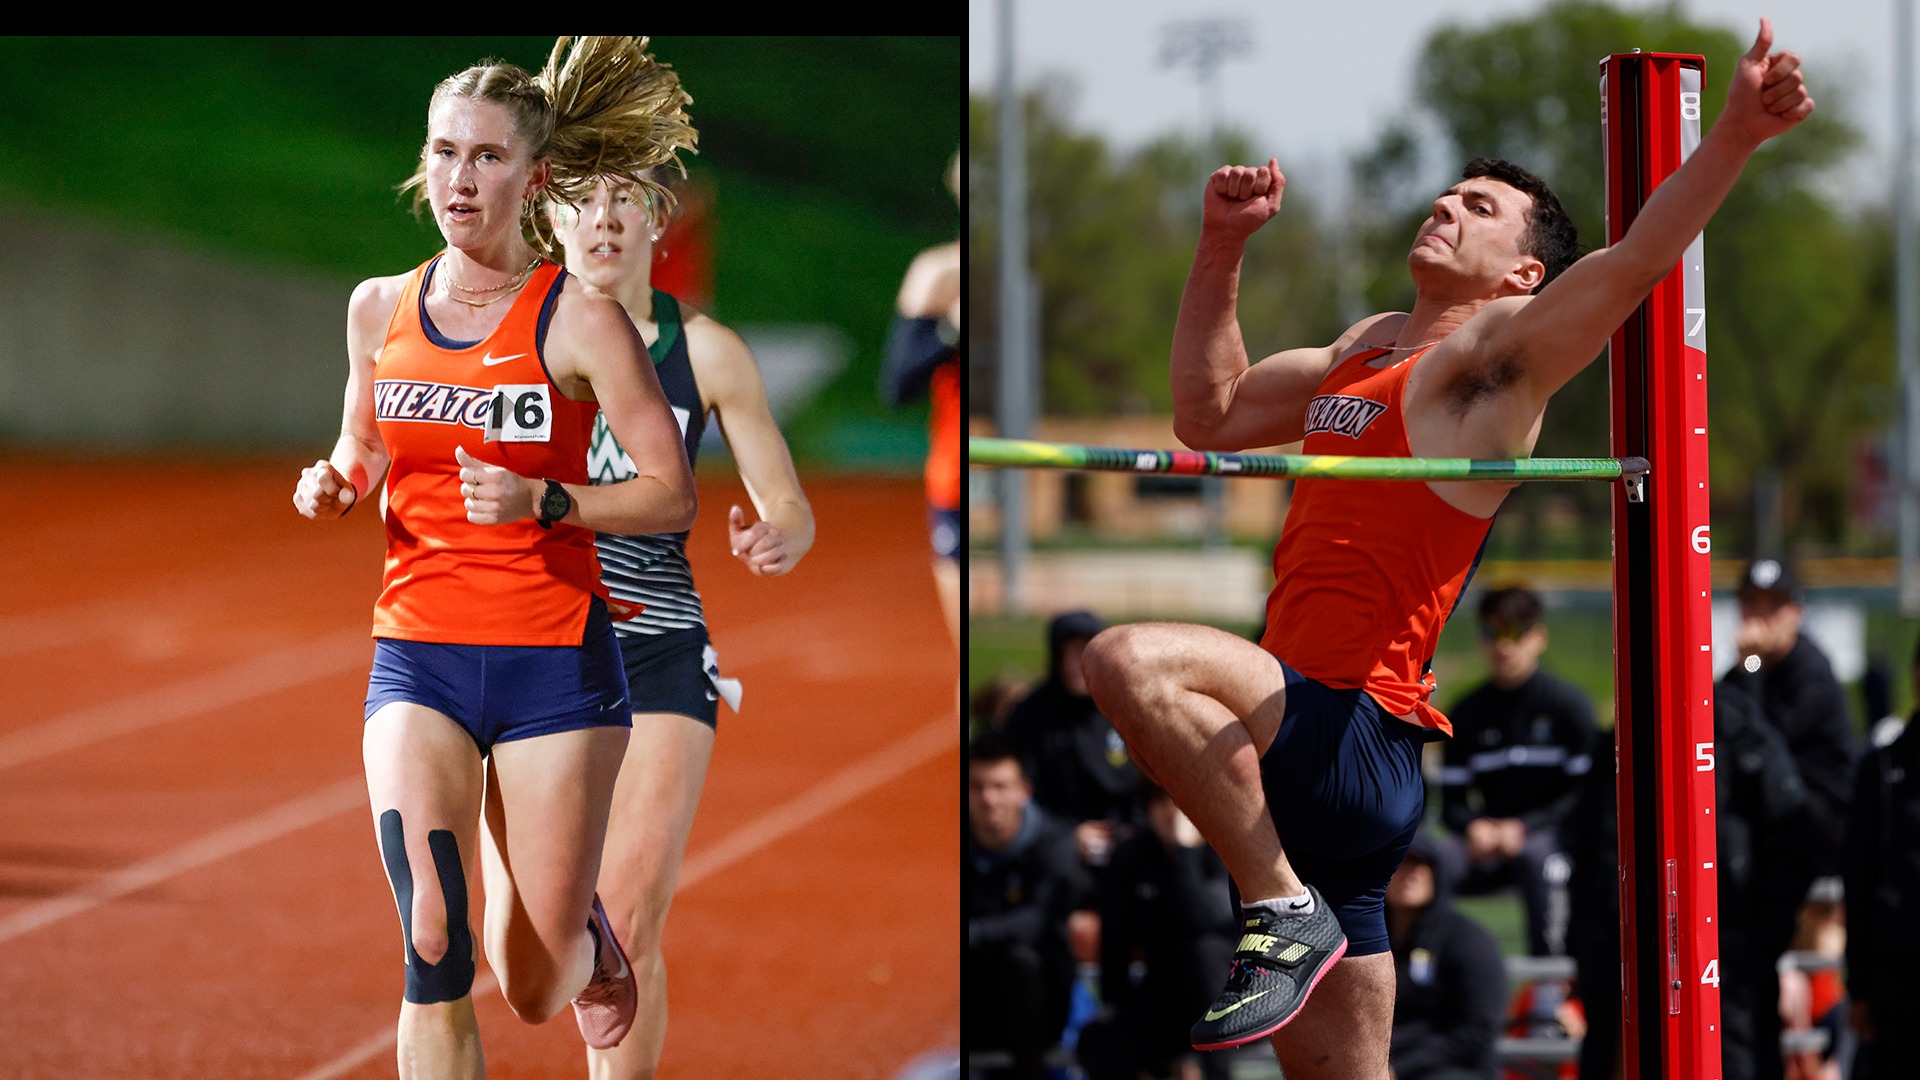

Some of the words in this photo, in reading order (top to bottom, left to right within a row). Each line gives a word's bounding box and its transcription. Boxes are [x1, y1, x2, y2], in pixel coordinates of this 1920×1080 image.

[1680, 92, 1701, 121] 8
[1686, 308, 1706, 337] 7
[374, 379, 491, 429] WHEATO
[489, 391, 545, 431] 16
[1691, 525, 1711, 554] 6
[1696, 742, 1715, 772] 5
[1246, 917, 1262, 928] NIKE
[1236, 933, 1279, 954] NIKE
[1700, 959, 1720, 988] 4
